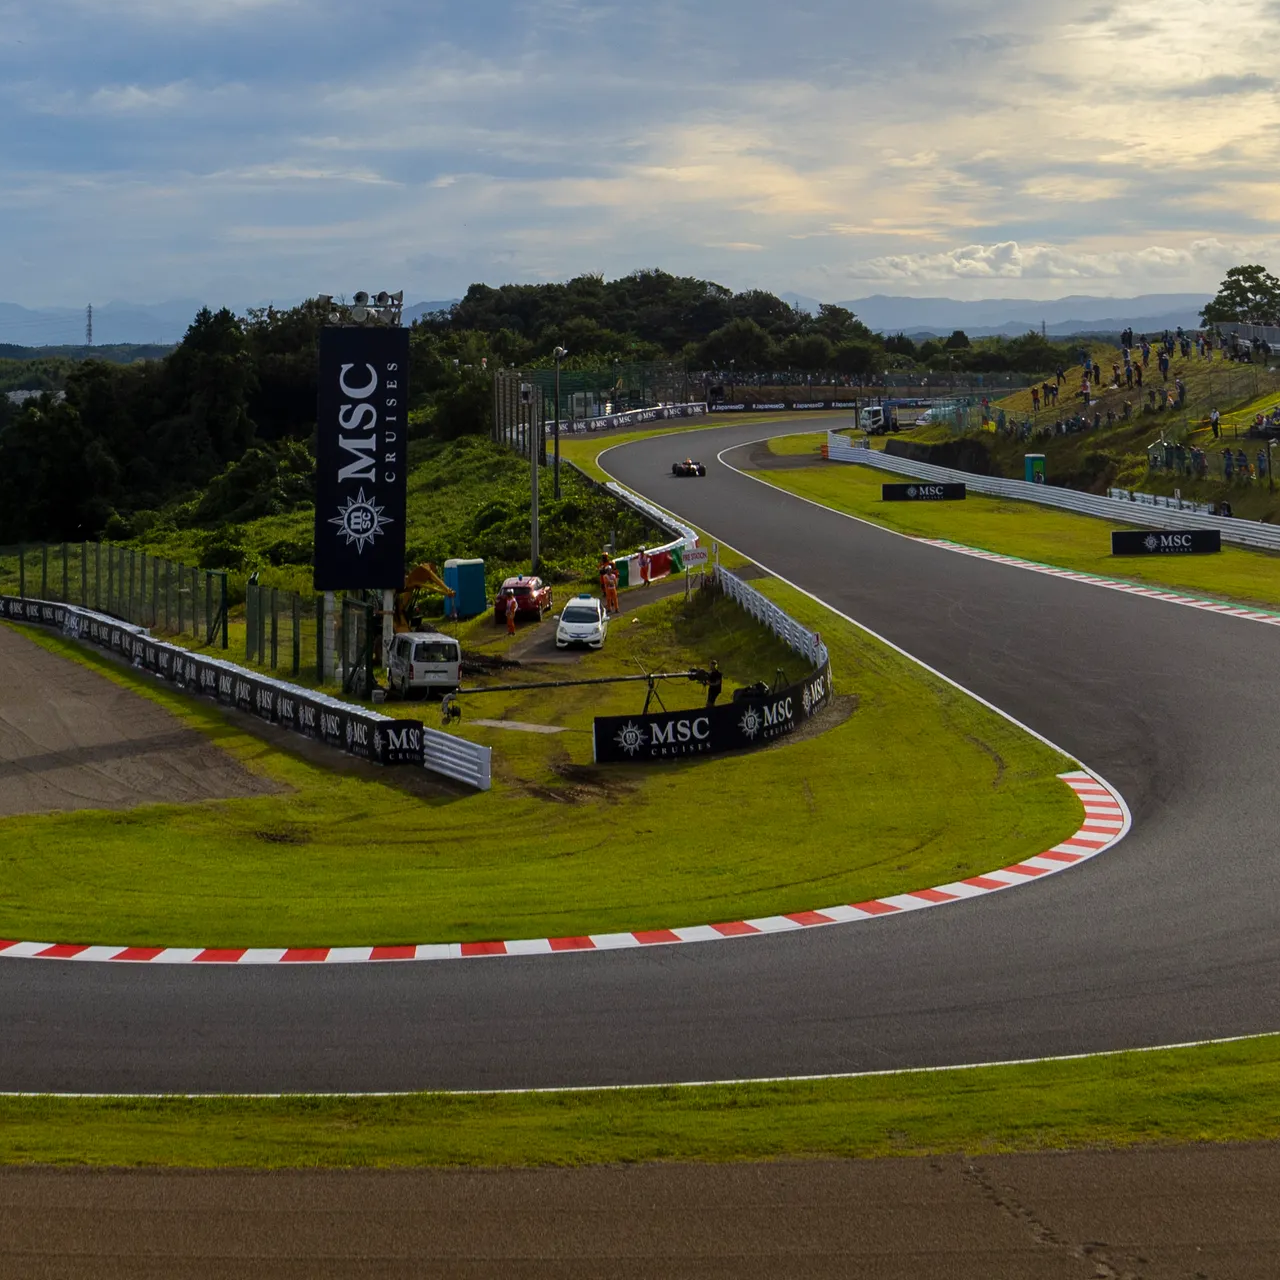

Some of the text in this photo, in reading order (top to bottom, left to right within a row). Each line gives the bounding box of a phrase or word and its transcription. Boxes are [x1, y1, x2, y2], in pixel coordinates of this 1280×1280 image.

[338, 363, 378, 483] MSC
[385, 362, 398, 483] CRUISES
[919, 486, 944, 495] MSC
[1160, 534, 1192, 546] MSC
[810, 675, 824, 704] MSC
[763, 697, 793, 727] MSC
[326, 713, 340, 736] MSC
[353, 721, 368, 745] MSC
[650, 717, 710, 745] MSC
[386, 728, 420, 750] MSC
[651, 743, 711, 756] CRUISES
